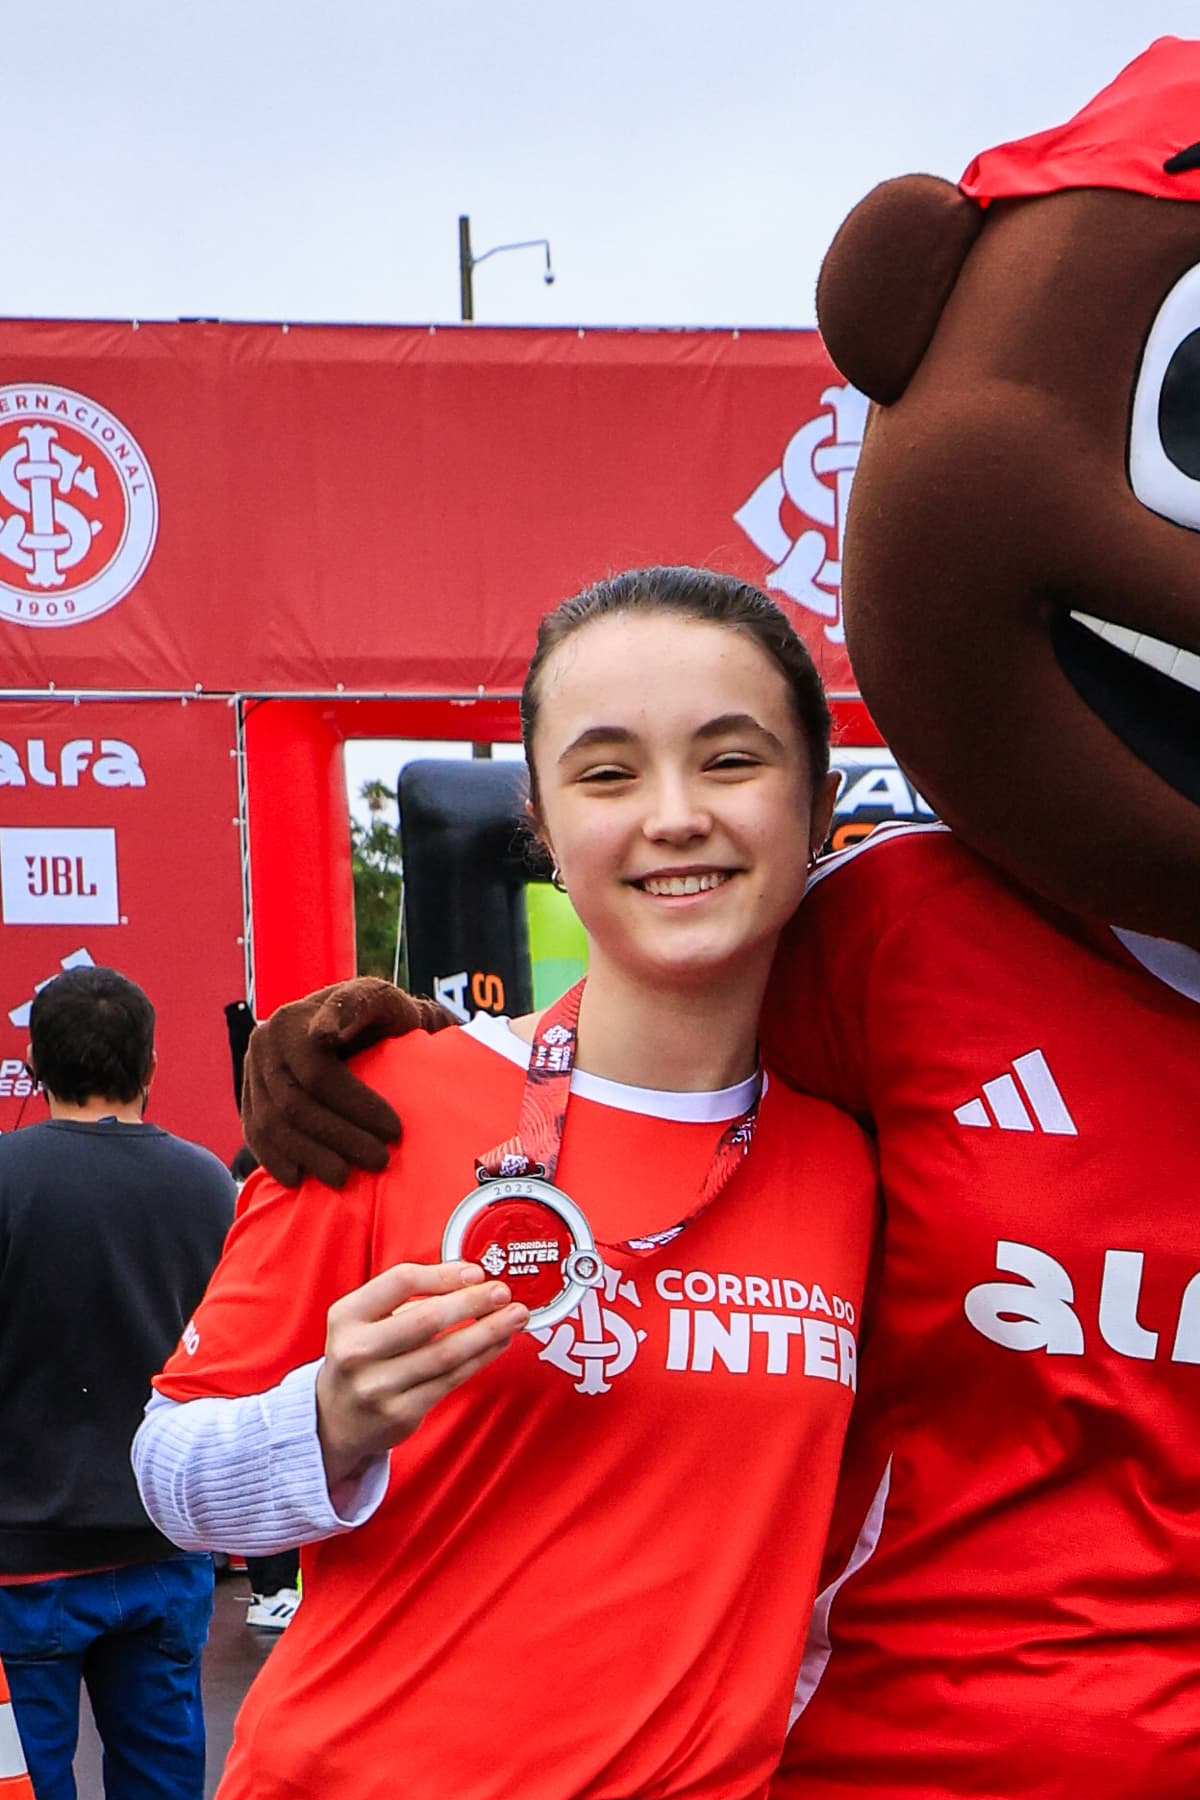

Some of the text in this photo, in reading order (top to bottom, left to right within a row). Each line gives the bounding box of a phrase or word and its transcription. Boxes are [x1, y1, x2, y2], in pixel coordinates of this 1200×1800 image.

[0, 394, 146, 497] ERNACIONAL
[15, 599, 76, 616] 1909
[26, 855, 98, 896] JBL
[493, 1183, 533, 1196] 2025
[507, 1241, 547, 1250] CORRIDA
[508, 1249, 559, 1264] INTER
[655, 1269, 856, 1326] CORRIDA DO
[665, 1308, 858, 1394] INTER
